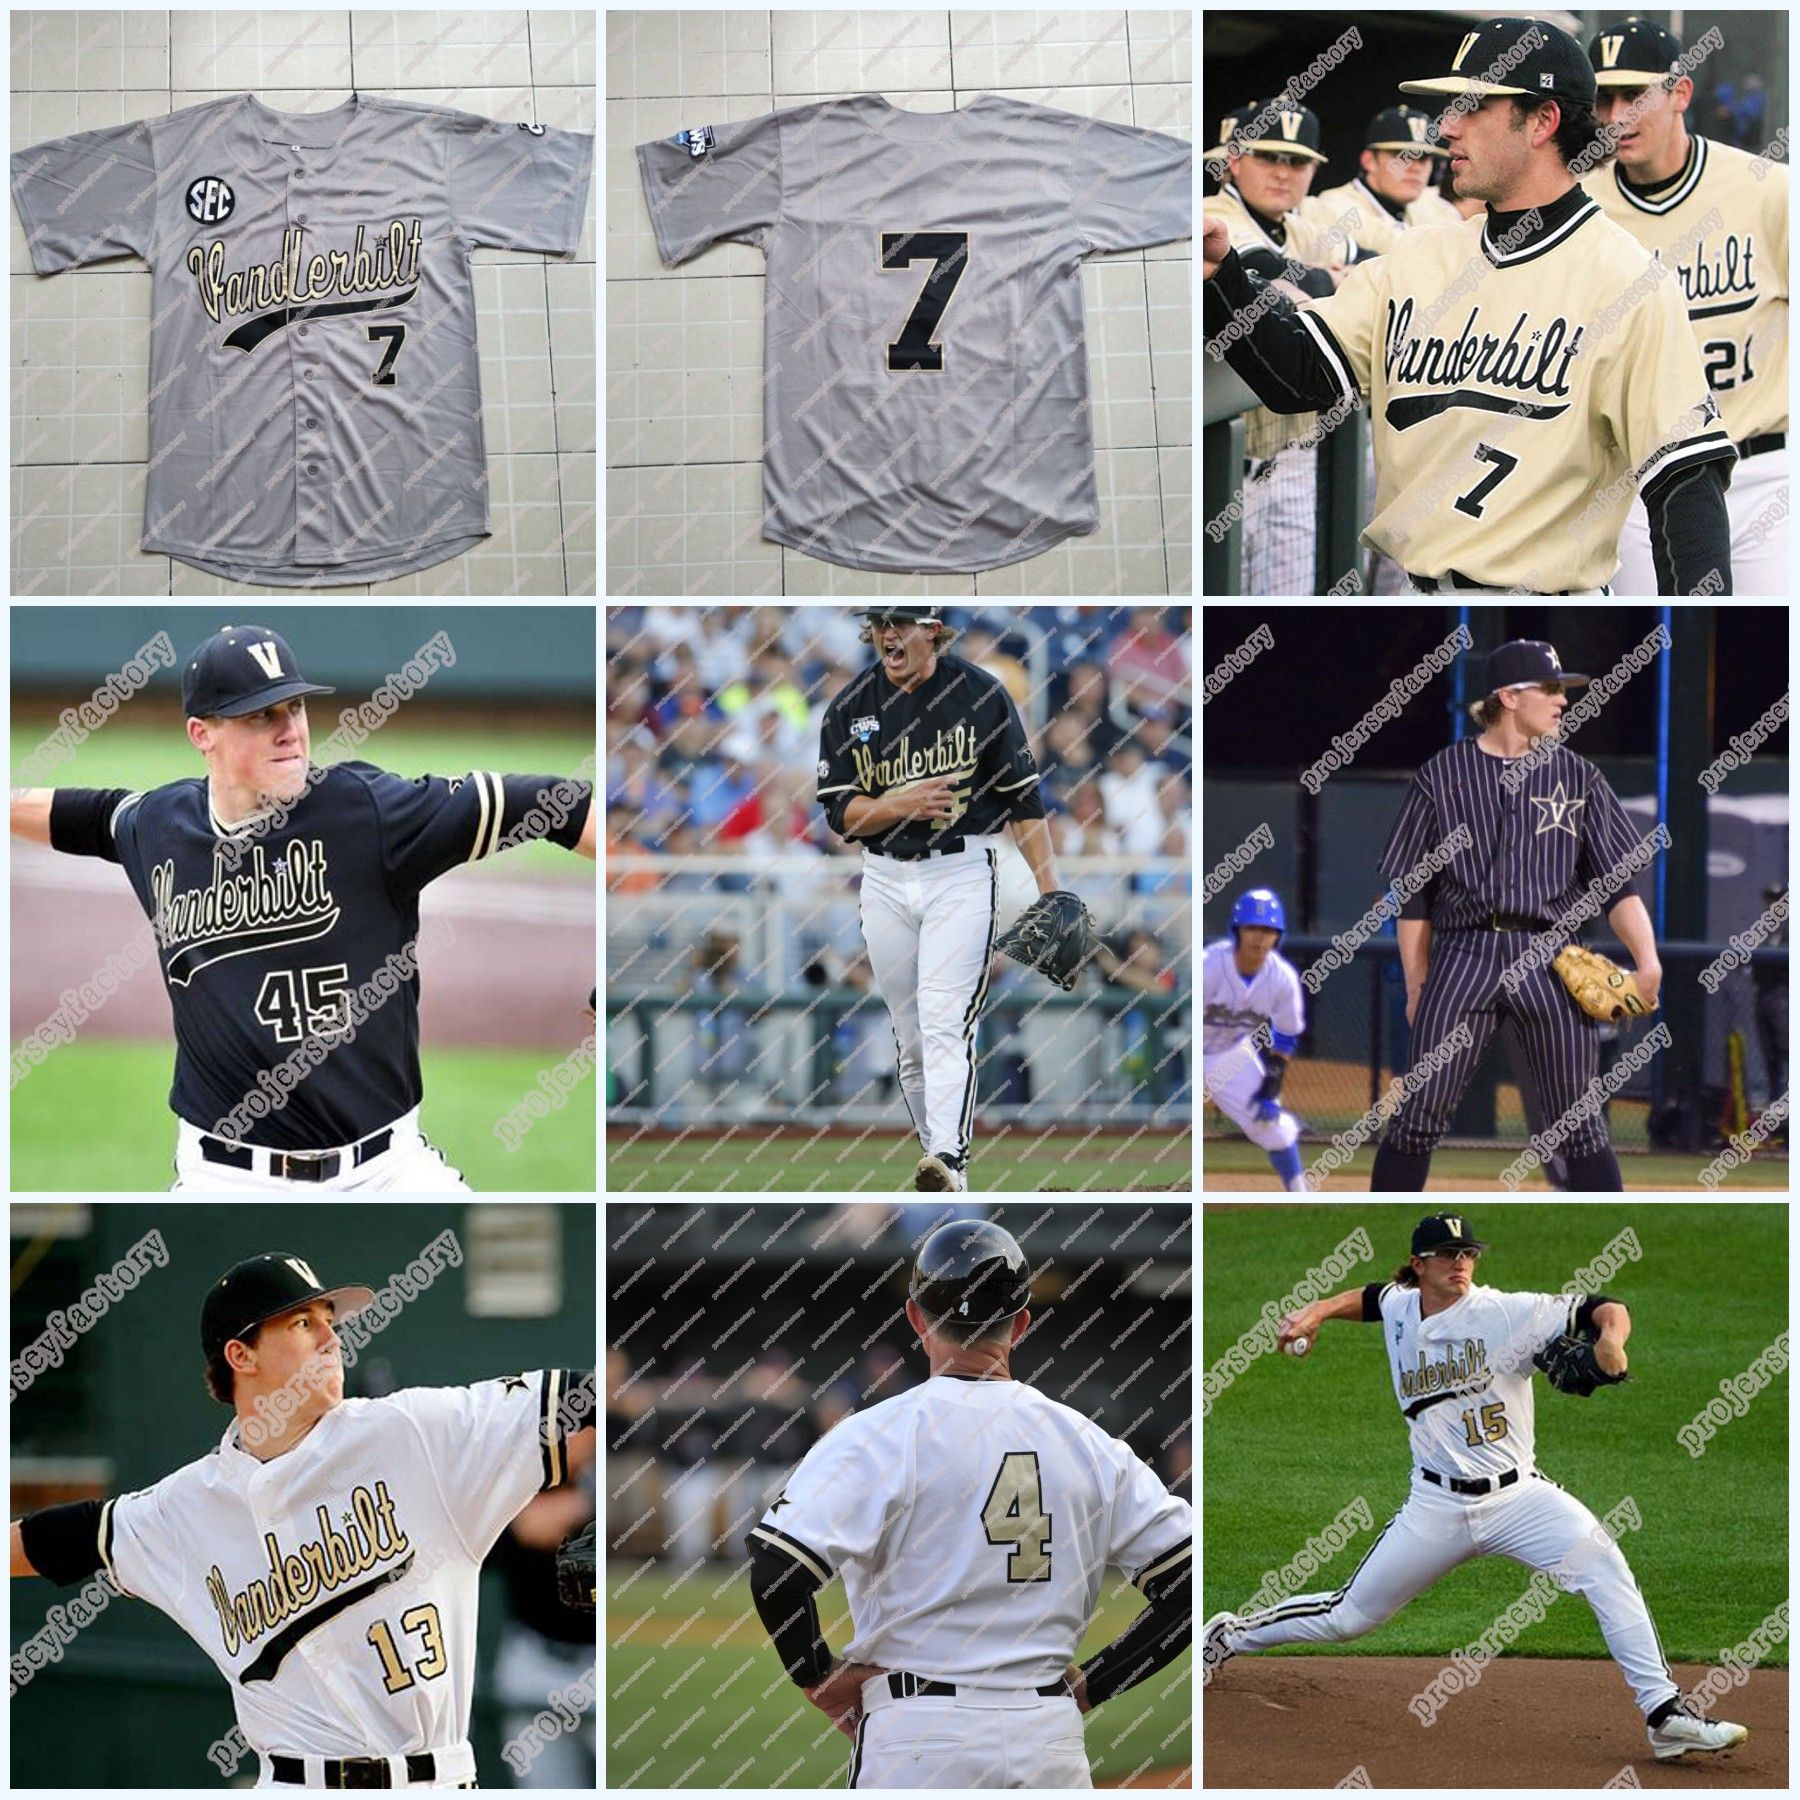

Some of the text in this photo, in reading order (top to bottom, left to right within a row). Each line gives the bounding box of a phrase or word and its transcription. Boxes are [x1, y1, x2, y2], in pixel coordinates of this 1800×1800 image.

[1451, 32, 1481, 71] V
[1601, 35, 1625, 67] V
[1280, 110, 1303, 141] V
[189, 179, 232, 221] SEC
[880, 230, 970, 372] 7
[367, 323, 406, 386] 7
[1385, 296, 1584, 397] Vanderbilt
[1703, 335, 1754, 391] 21
[1453, 442, 1519, 519] 7
[248, 641, 286, 680] V
[1551, 802, 1567, 823] V
[152, 838, 333, 950] Vanderbilt
[254, 963, 351, 1043] 45
[1445, 1218, 1462, 1239] V
[284, 1257, 326, 1290] V
[958, 1301, 970, 1316] 4
[1462, 1401, 1508, 1448] 15
[980, 1450, 1053, 1584] 4
[206, 1480, 409, 1657] Vanderbilt
[365, 1602, 448, 1696] 13
